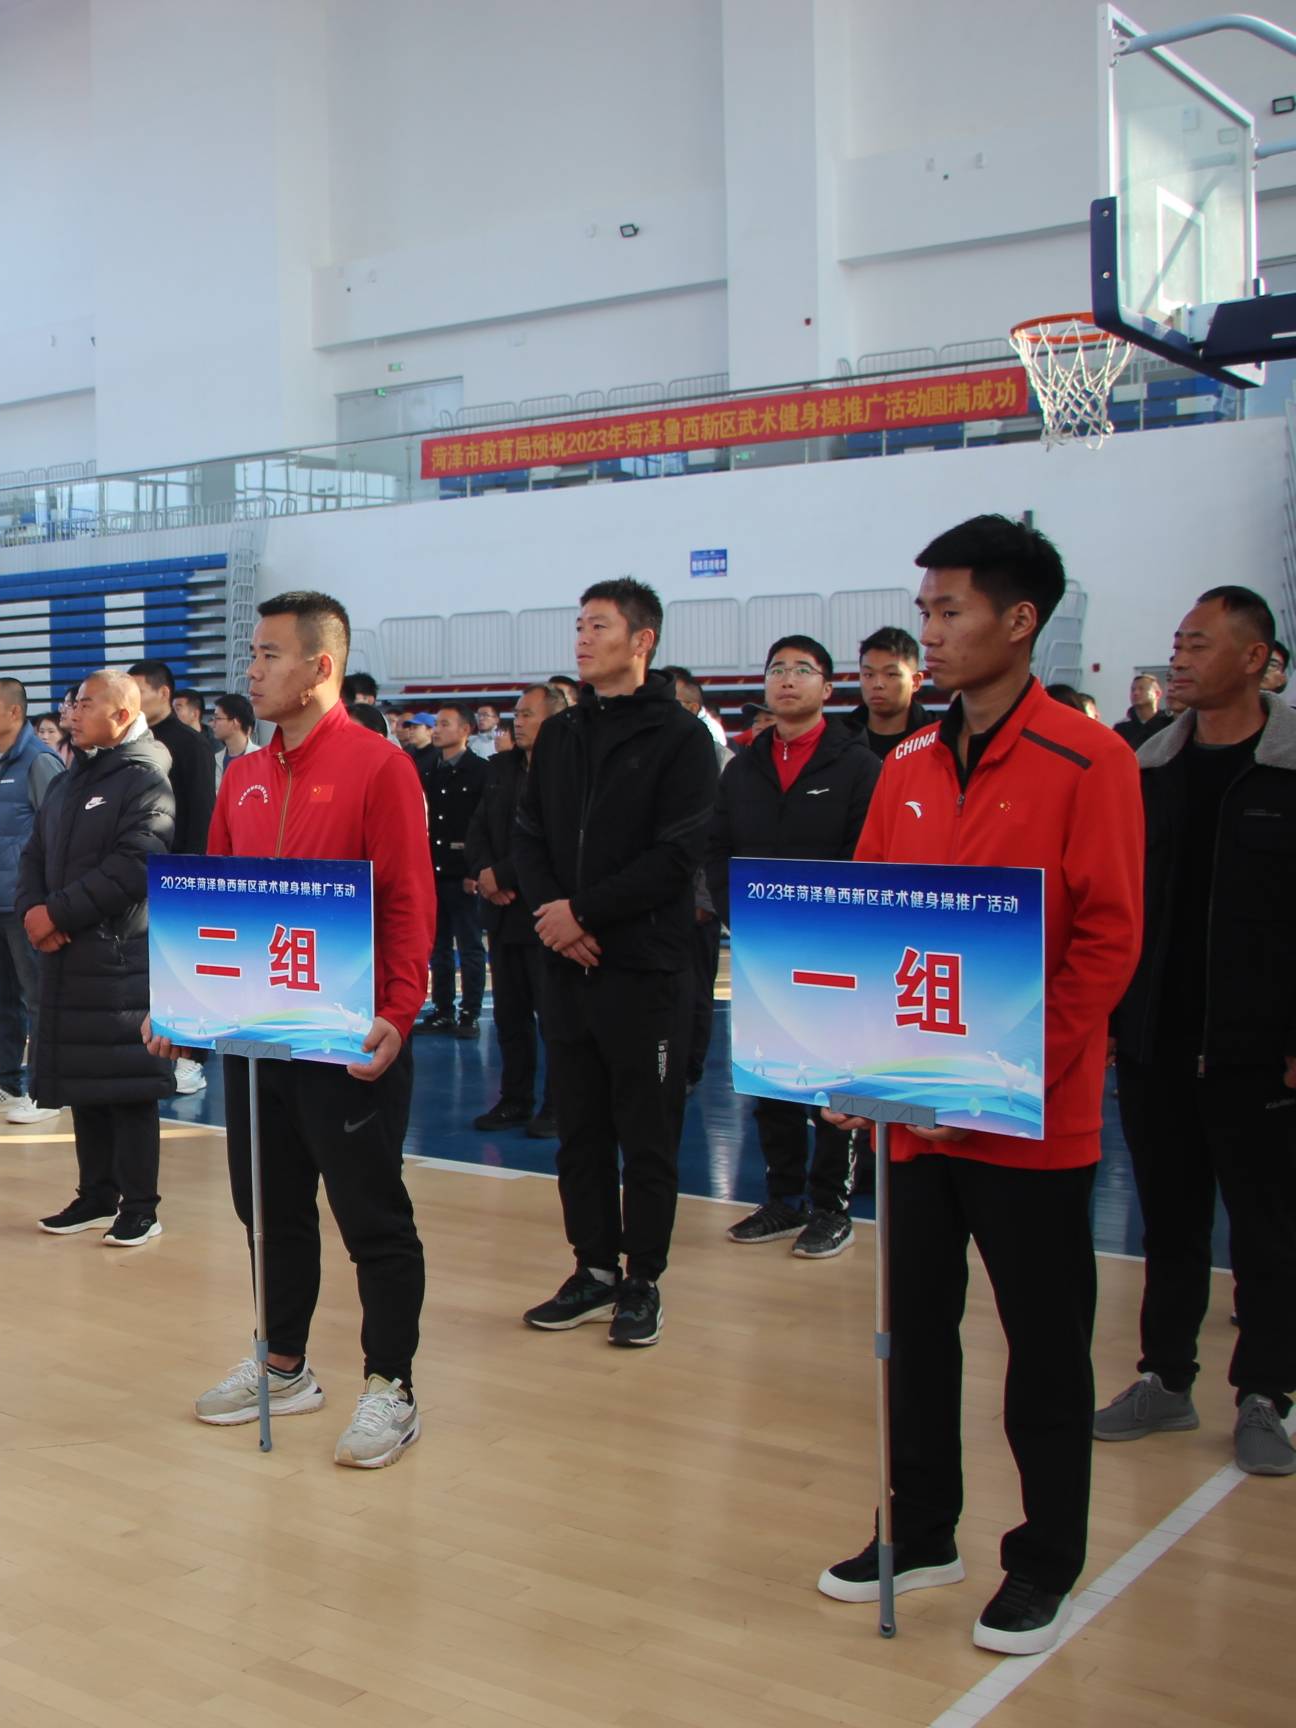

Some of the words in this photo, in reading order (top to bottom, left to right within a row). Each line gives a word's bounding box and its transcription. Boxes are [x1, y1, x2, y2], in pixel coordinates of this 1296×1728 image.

[431, 377, 1016, 471] 菏泽市教育局预祝2023年菏泽鲁西新区武术健身操推广活动圆满成功
[895, 731, 936, 760] CHINA
[160, 876, 356, 898] 2023年菏泽鲁西新区武术健身操推广活动
[747, 882, 1018, 914] 2023年菏泽鲁西新区武术健身操推广活动
[195, 924, 321, 992] 二组
[792, 946, 967, 1036] 一组
